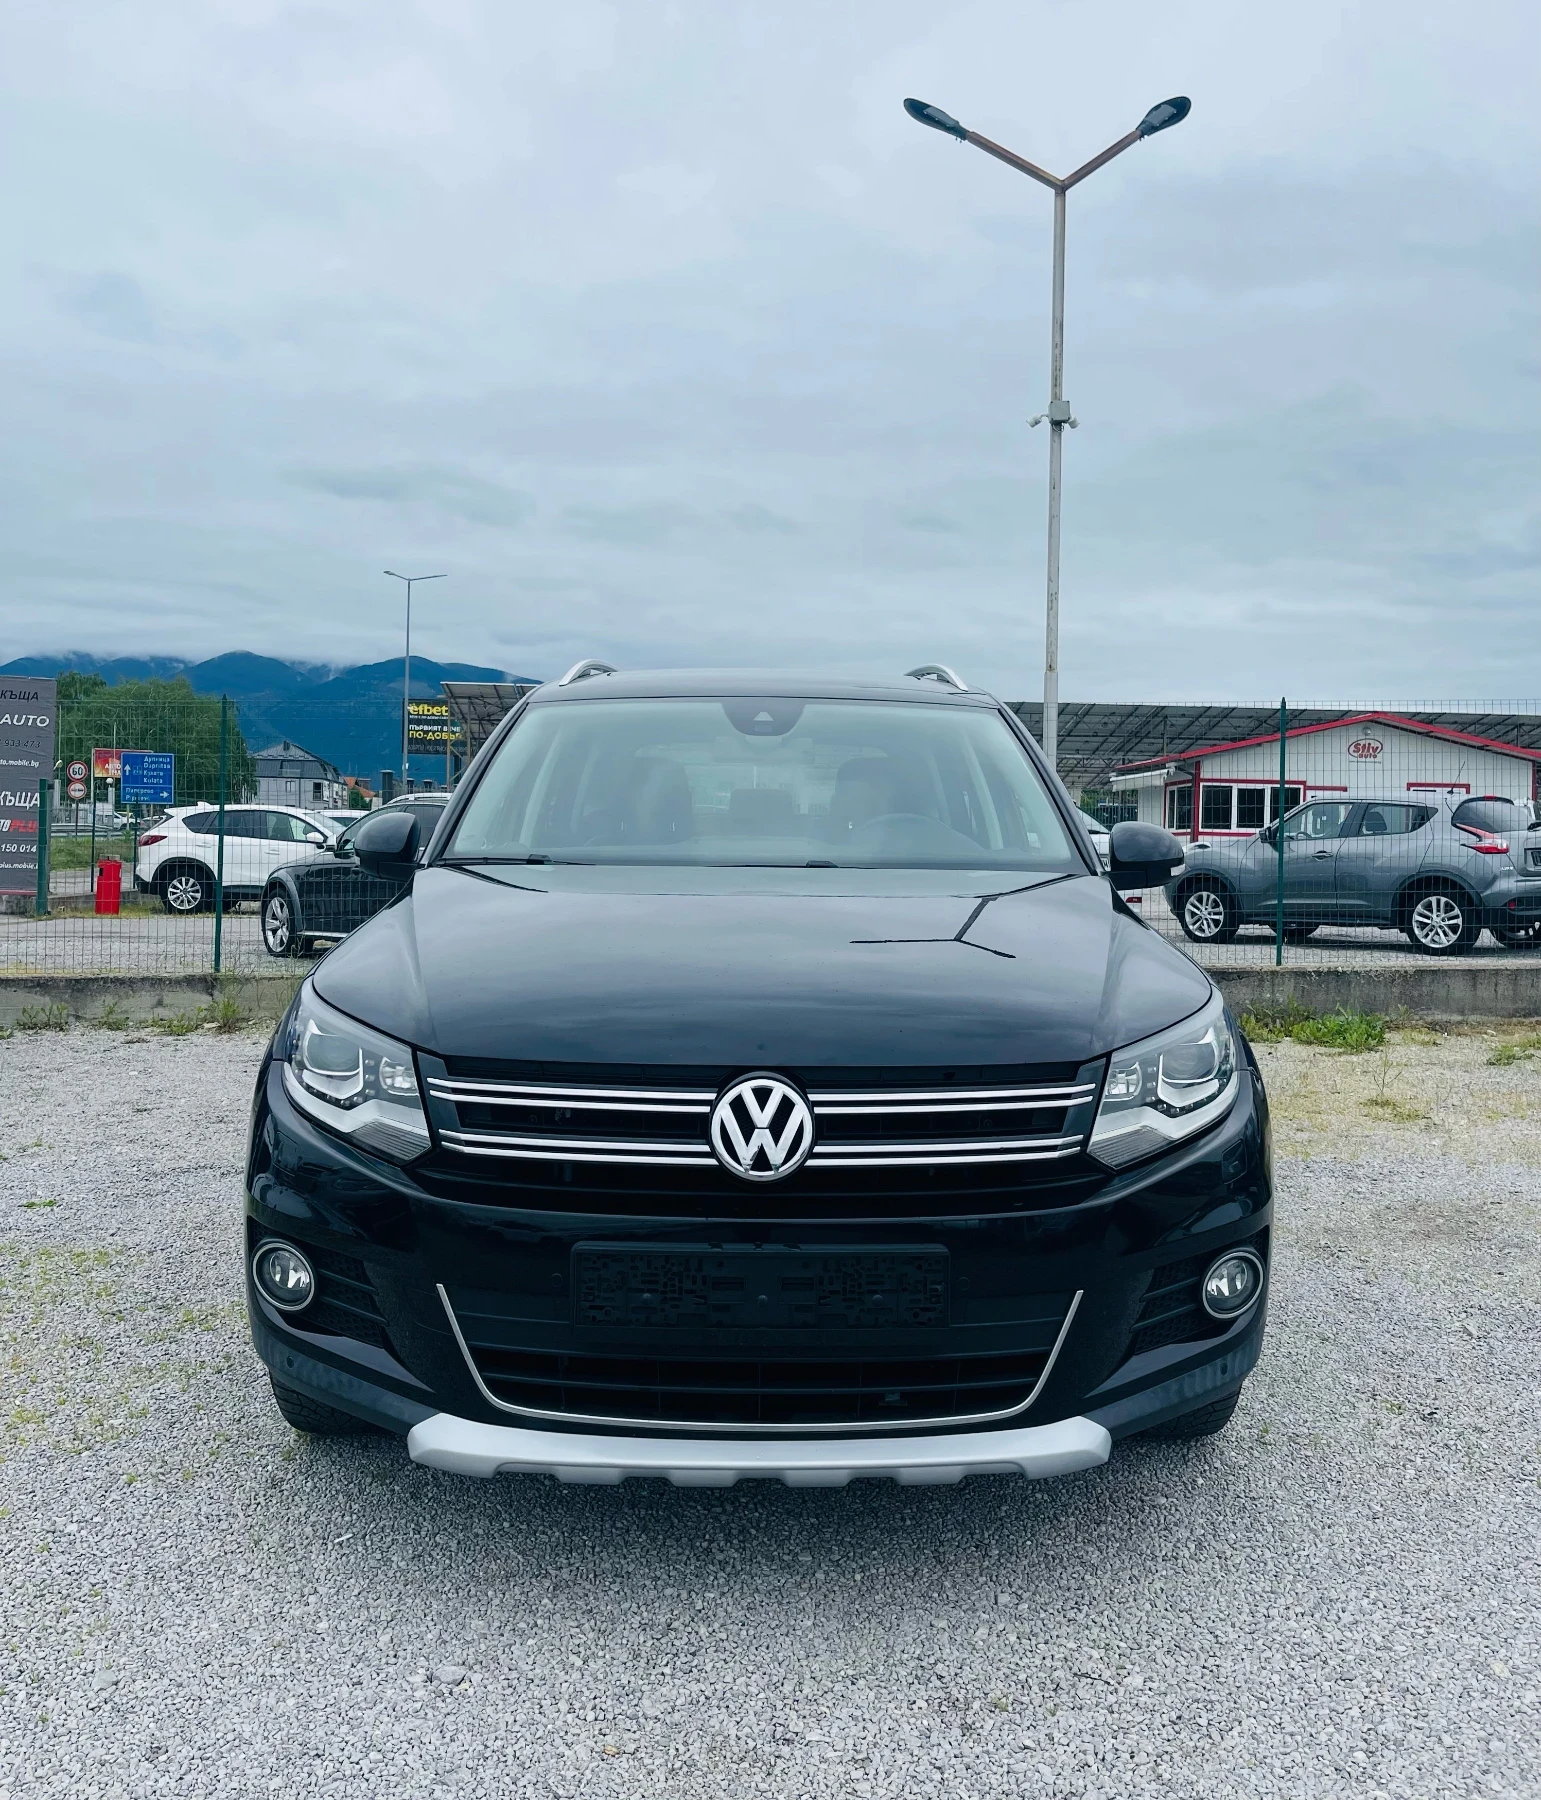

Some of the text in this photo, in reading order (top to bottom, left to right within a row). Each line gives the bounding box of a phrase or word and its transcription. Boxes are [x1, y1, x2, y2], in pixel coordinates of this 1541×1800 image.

[408, 703, 449, 716] efbet
[0, 713, 50, 727] AUTO
[4, 739, 41, 749] 933 473
[1352, 742, 1379, 754] Stiv
[71, 767, 84, 776] 60
[0, 843, 18, 853] 150
